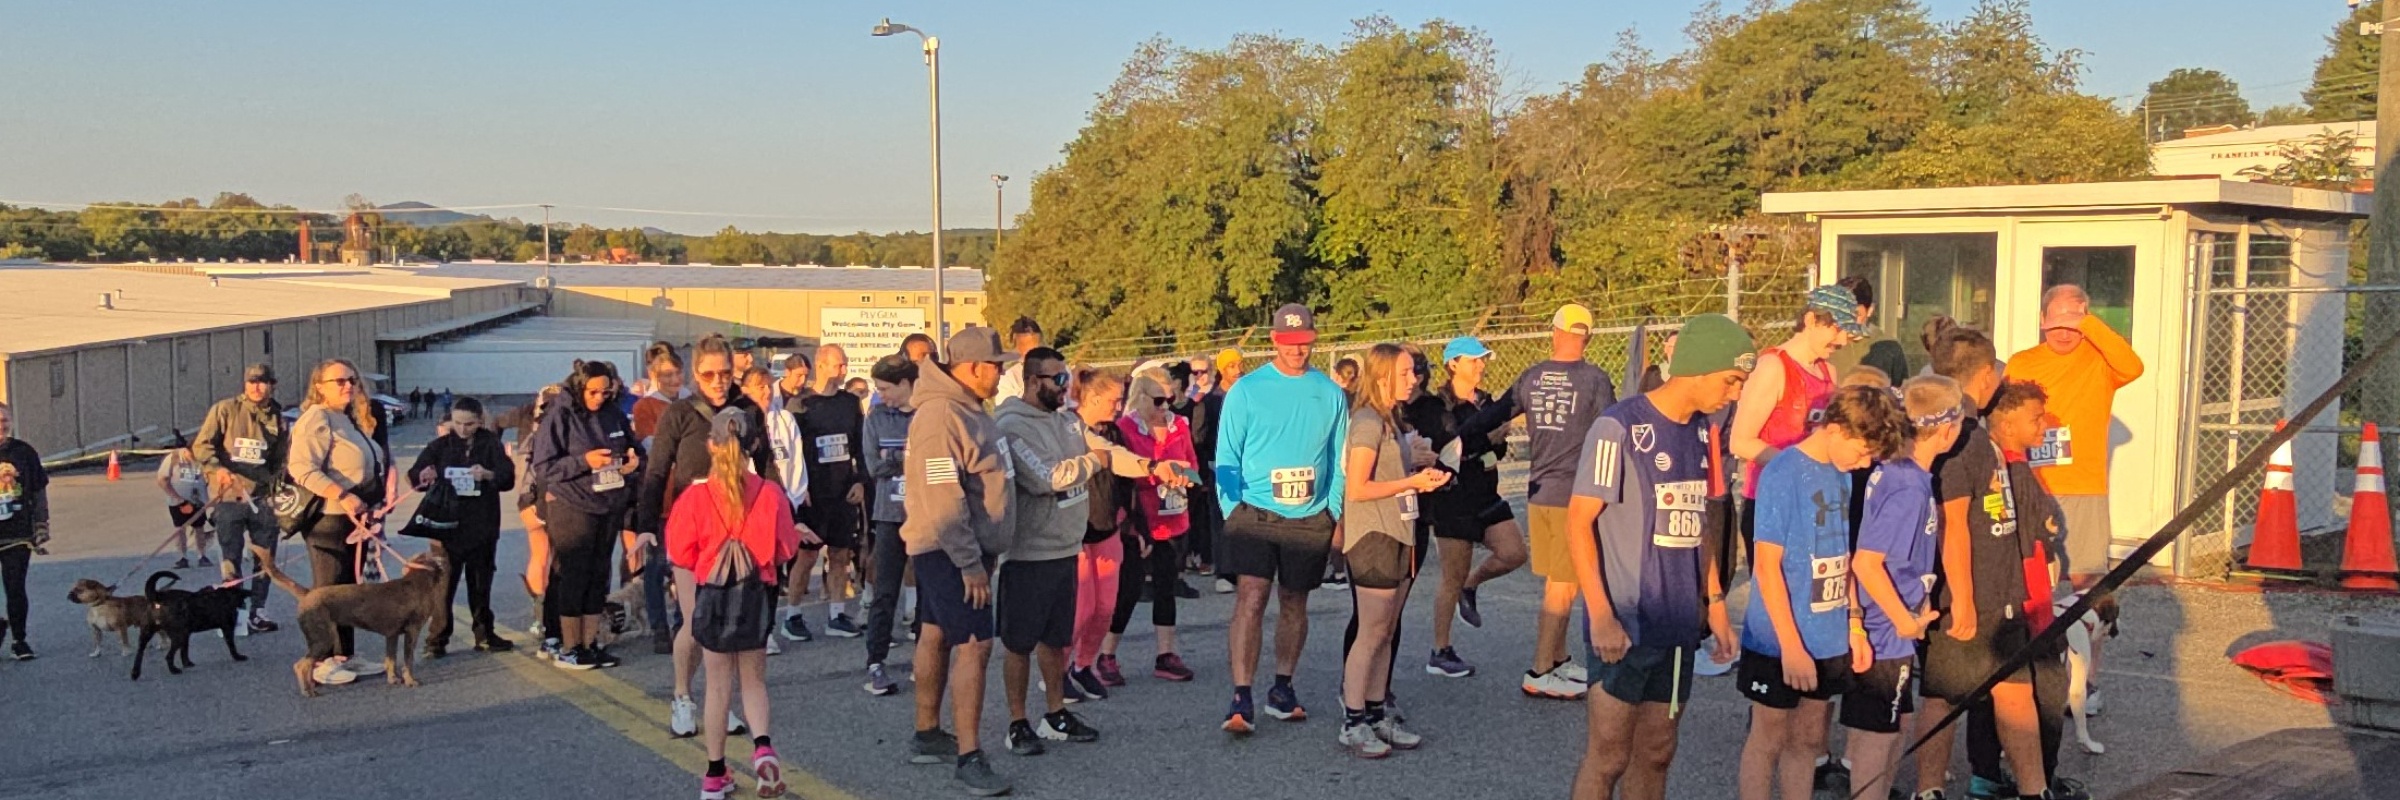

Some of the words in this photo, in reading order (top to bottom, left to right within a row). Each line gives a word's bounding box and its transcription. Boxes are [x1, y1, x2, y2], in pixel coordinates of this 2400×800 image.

[860, 310, 876, 319] PLY
[877, 310, 898, 319] GEM
[882, 321, 895, 329] Ply
[1282, 481, 1307, 498] 879
[1669, 510, 1701, 537] 868
